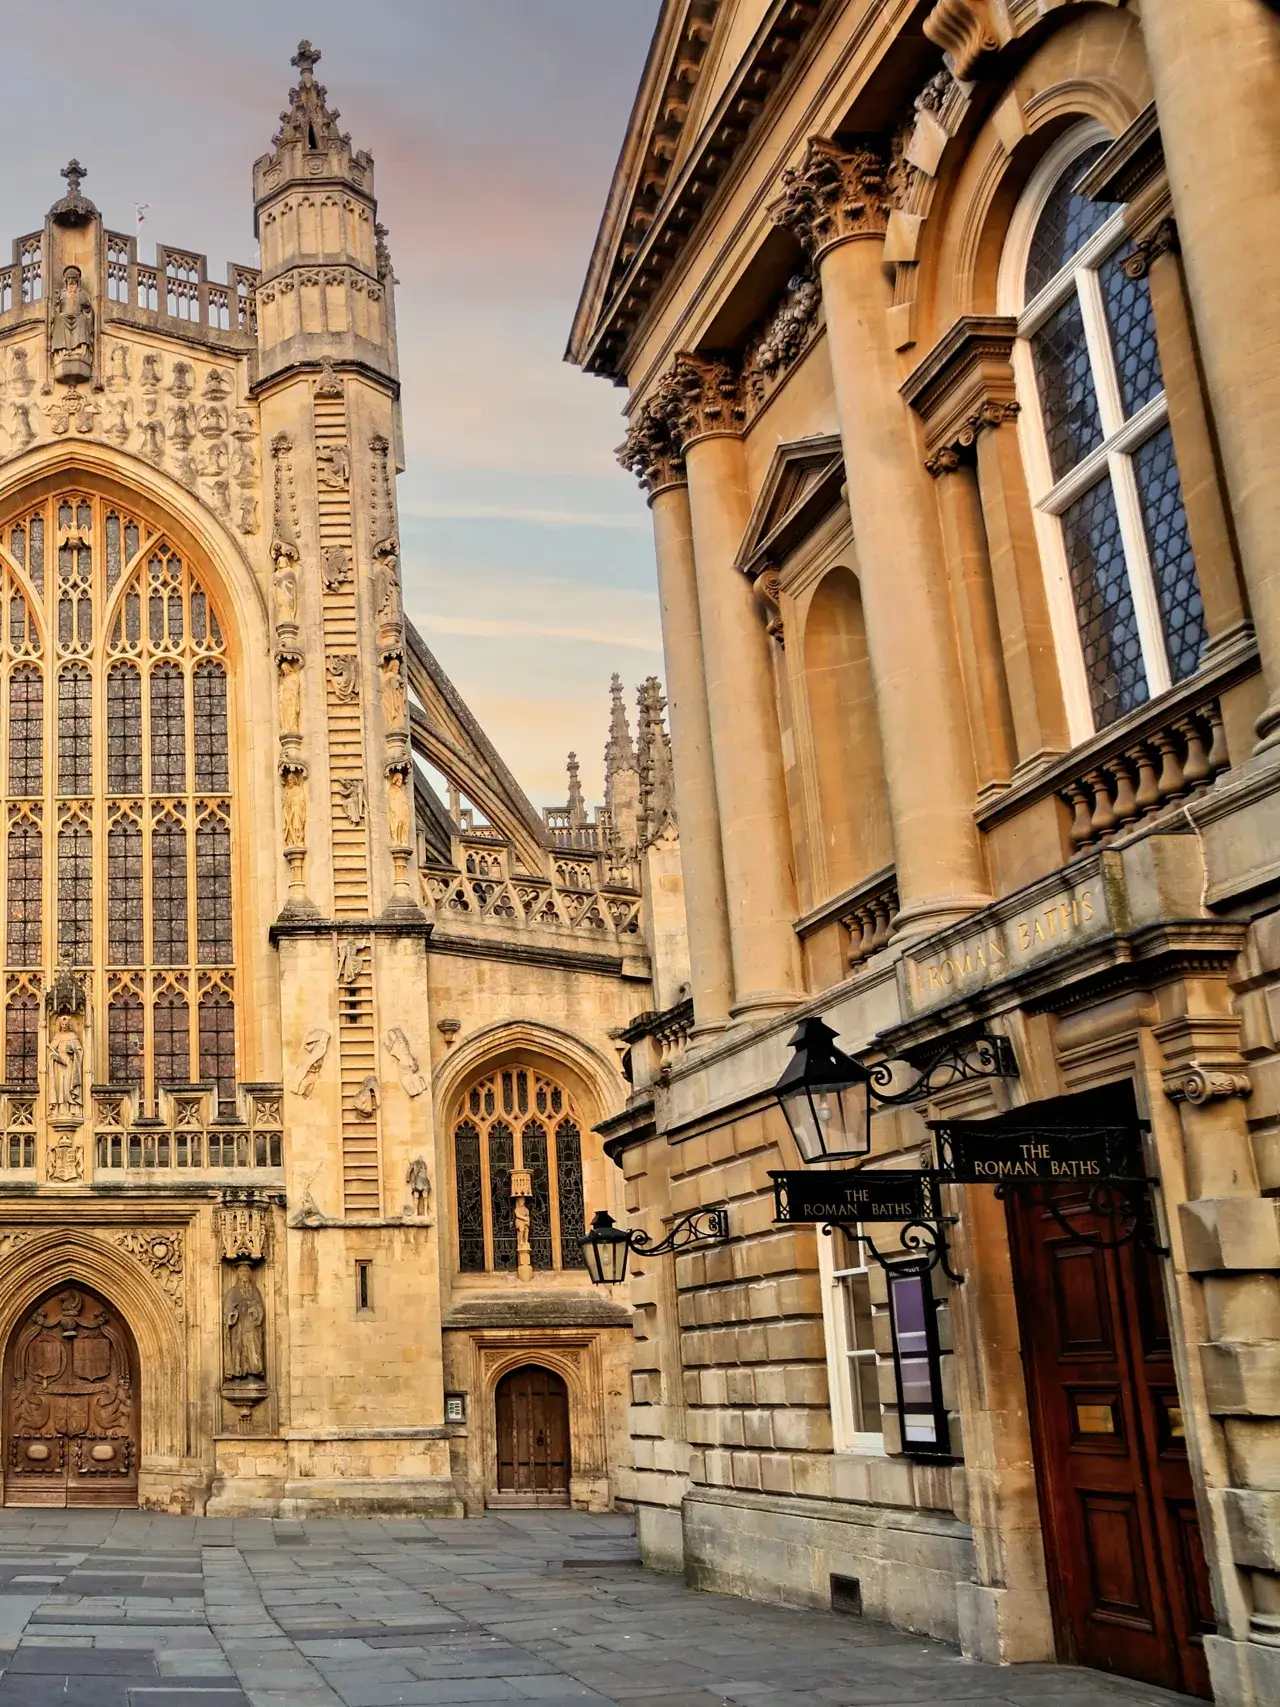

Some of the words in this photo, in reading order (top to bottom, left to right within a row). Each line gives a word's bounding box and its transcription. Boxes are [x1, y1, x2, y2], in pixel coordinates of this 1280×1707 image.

[928, 937, 1006, 990] ROMAN
[1017, 891, 1095, 952] BATHS
[1019, 1144, 1051, 1159] THE
[974, 1161, 1039, 1176] ROMAN
[1051, 1160, 1100, 1175] BATHS
[844, 1189, 870, 1202] THE
[803, 1203, 859, 1216] ROMAN
[871, 1202, 912, 1215] BATHS
